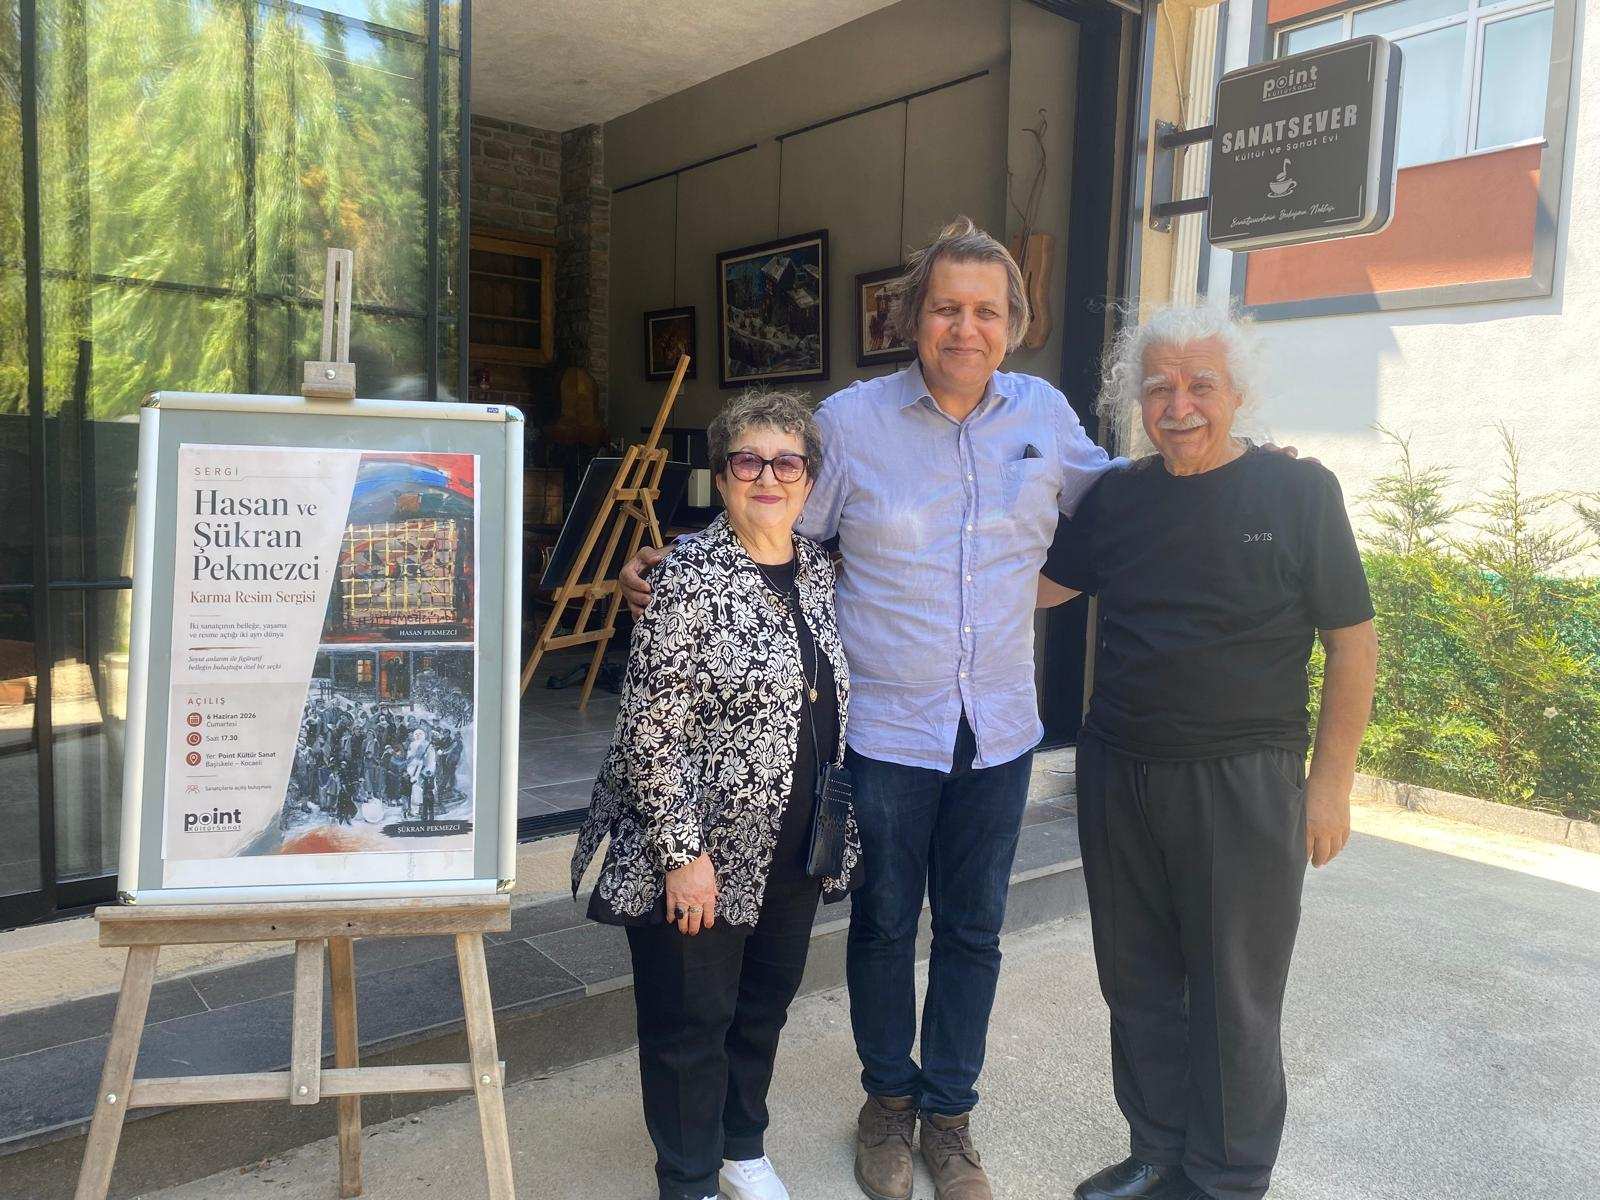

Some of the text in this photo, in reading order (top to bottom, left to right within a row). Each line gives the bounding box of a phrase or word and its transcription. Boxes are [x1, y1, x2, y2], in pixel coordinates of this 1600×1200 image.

[1263, 65, 1318, 99] point
[1221, 104, 1358, 154] SANATSEVER
[1269, 146, 1281, 154] ve
[1286, 138, 1317, 151] Sanat
[1322, 134, 1338, 144] Evi
[194, 489, 318, 516] Hasan ve
[193, 521, 301, 554] Şükran
[192, 555, 319, 581] Pekmezci
[191, 590, 316, 605] Karma Resim Sergisi
[188, 697, 226, 706] AÇILIŞ
[184, 807, 241, 831] point
